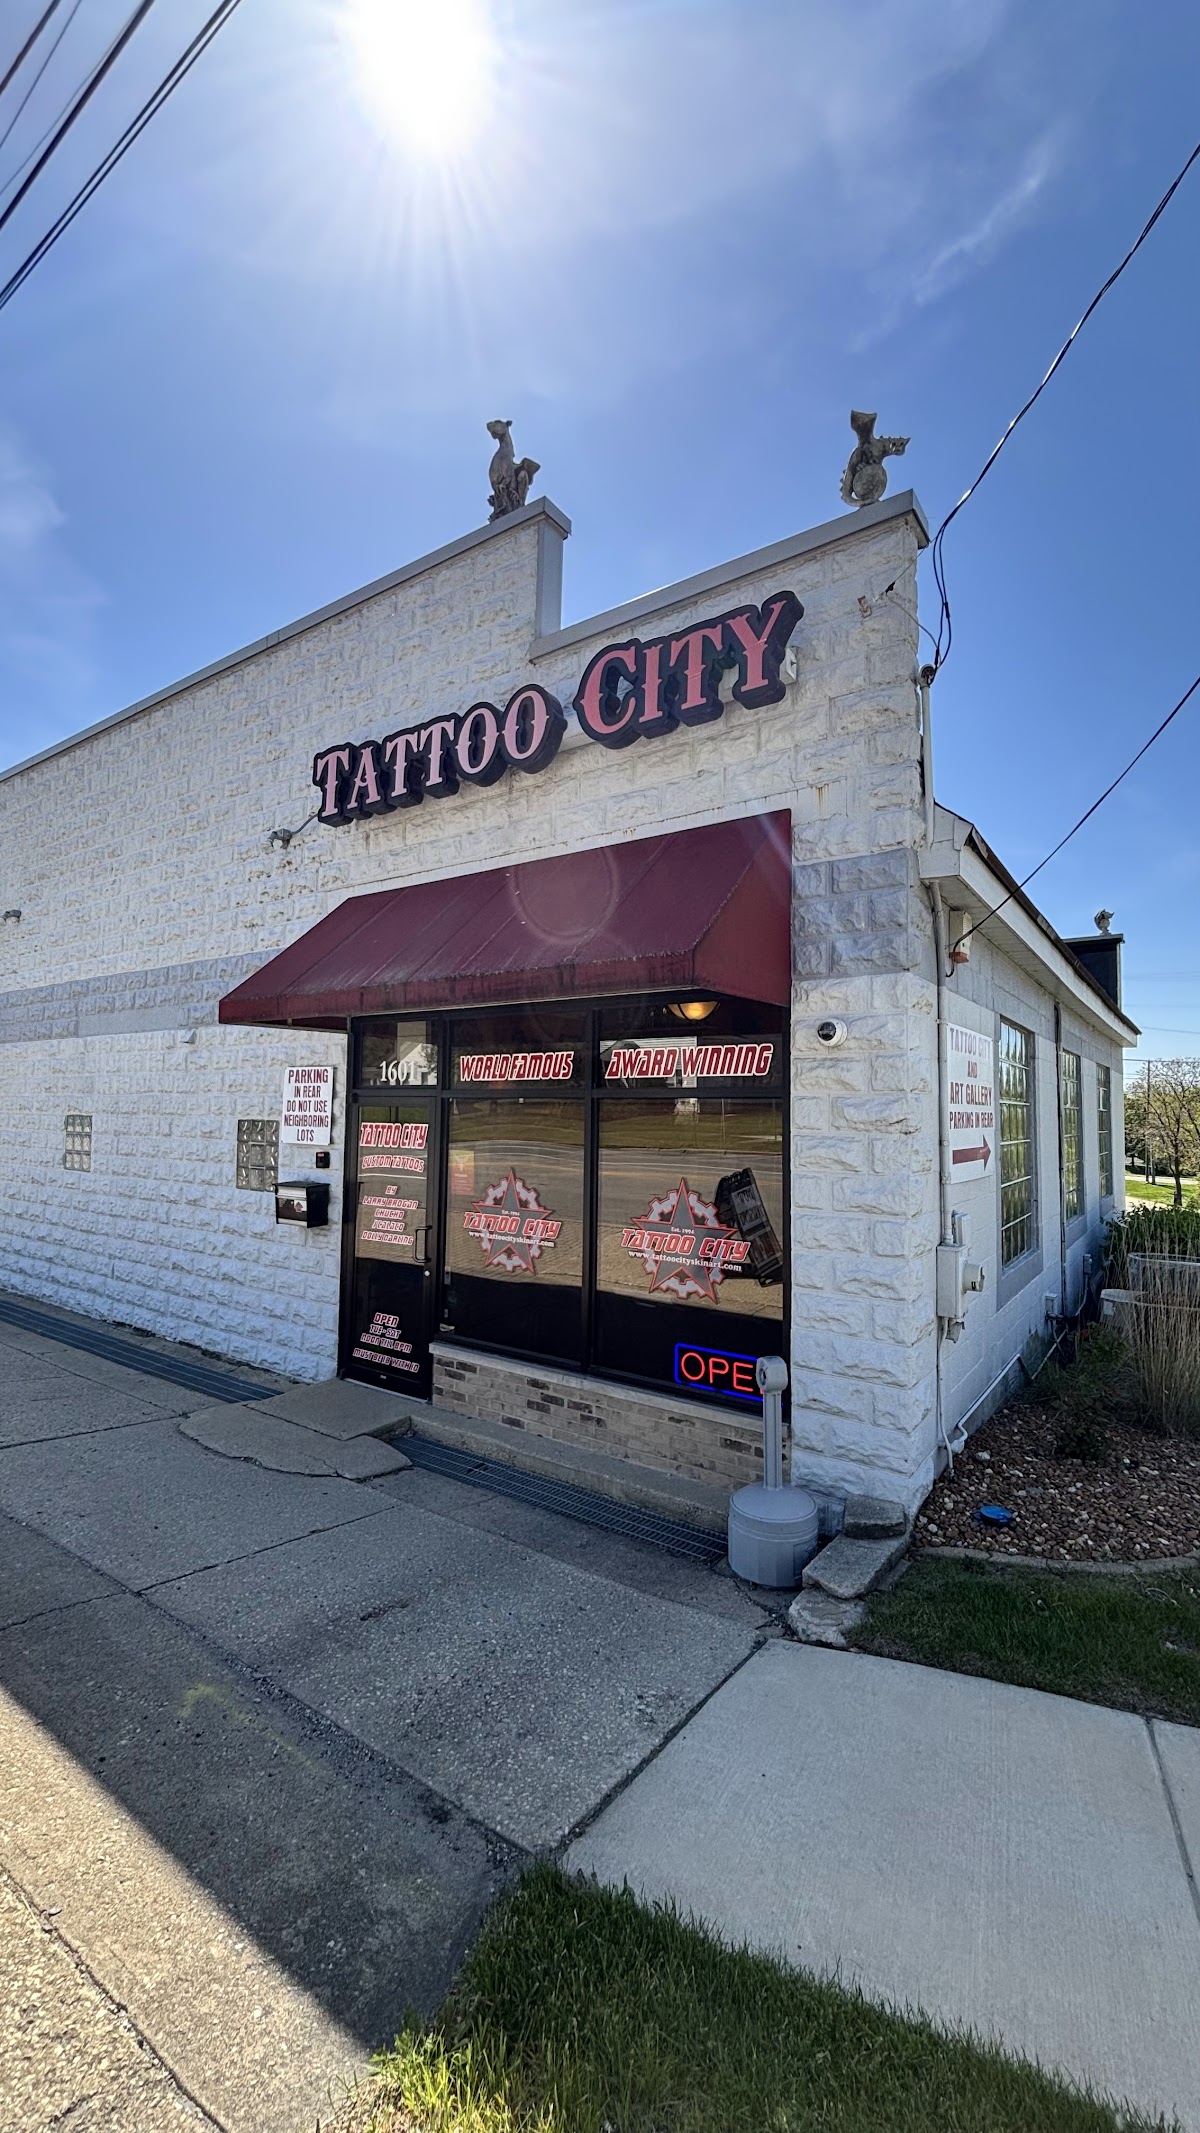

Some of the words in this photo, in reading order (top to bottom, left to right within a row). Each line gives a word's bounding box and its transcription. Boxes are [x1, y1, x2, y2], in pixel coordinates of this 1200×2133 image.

[314, 688, 554, 820] TATTOO
[579, 598, 788, 737] CITY
[950, 1028, 976, 1056] TATTOO
[379, 1060, 416, 1082] 1601
[460, 1054, 510, 1081] WORLD
[508, 1051, 574, 1081] FAMOUS
[605, 1048, 679, 1079] AWARD
[680, 1043, 773, 1077] WINNING
[967, 1061, 977, 1078] AND
[288, 1068, 328, 1084] PARKING
[294, 1086, 301, 1098] IN
[303, 1086, 321, 1098] REAR
[950, 1081, 963, 1105] ART
[966, 1083, 992, 1106] GALLERY
[287, 1100, 296, 1112] DO
[298, 1100, 311, 1112] NOT
[314, 1100, 327, 1113] USE
[284, 1114, 329, 1128] NEIGHBORING
[949, 1111, 974, 1129] PARKING
[975, 1111, 980, 1128] IN
[981, 1112, 993, 1128] REAR
[297, 1129, 314, 1142] LOTS
[360, 1122, 401, 1147] TATTOO
[401, 1123, 428, 1149] CITY
[362, 1155, 392, 1169] CUSTOM
[391, 1155, 425, 1173] TATTOOS
[385, 1185, 397, 1195] BY
[362, 1195, 386, 1208] LARRY
[463, 1211, 520, 1234] TATTOO
[522, 1218, 562, 1239] CITY
[621, 1228, 696, 1255] TATTOO
[699, 1238, 751, 1261] CITY
[628, 1250, 742, 1272] www.tattoocityskinart.com
[373, 1312, 399, 1328] OPEN
[681, 1352, 764, 1395] OPE
